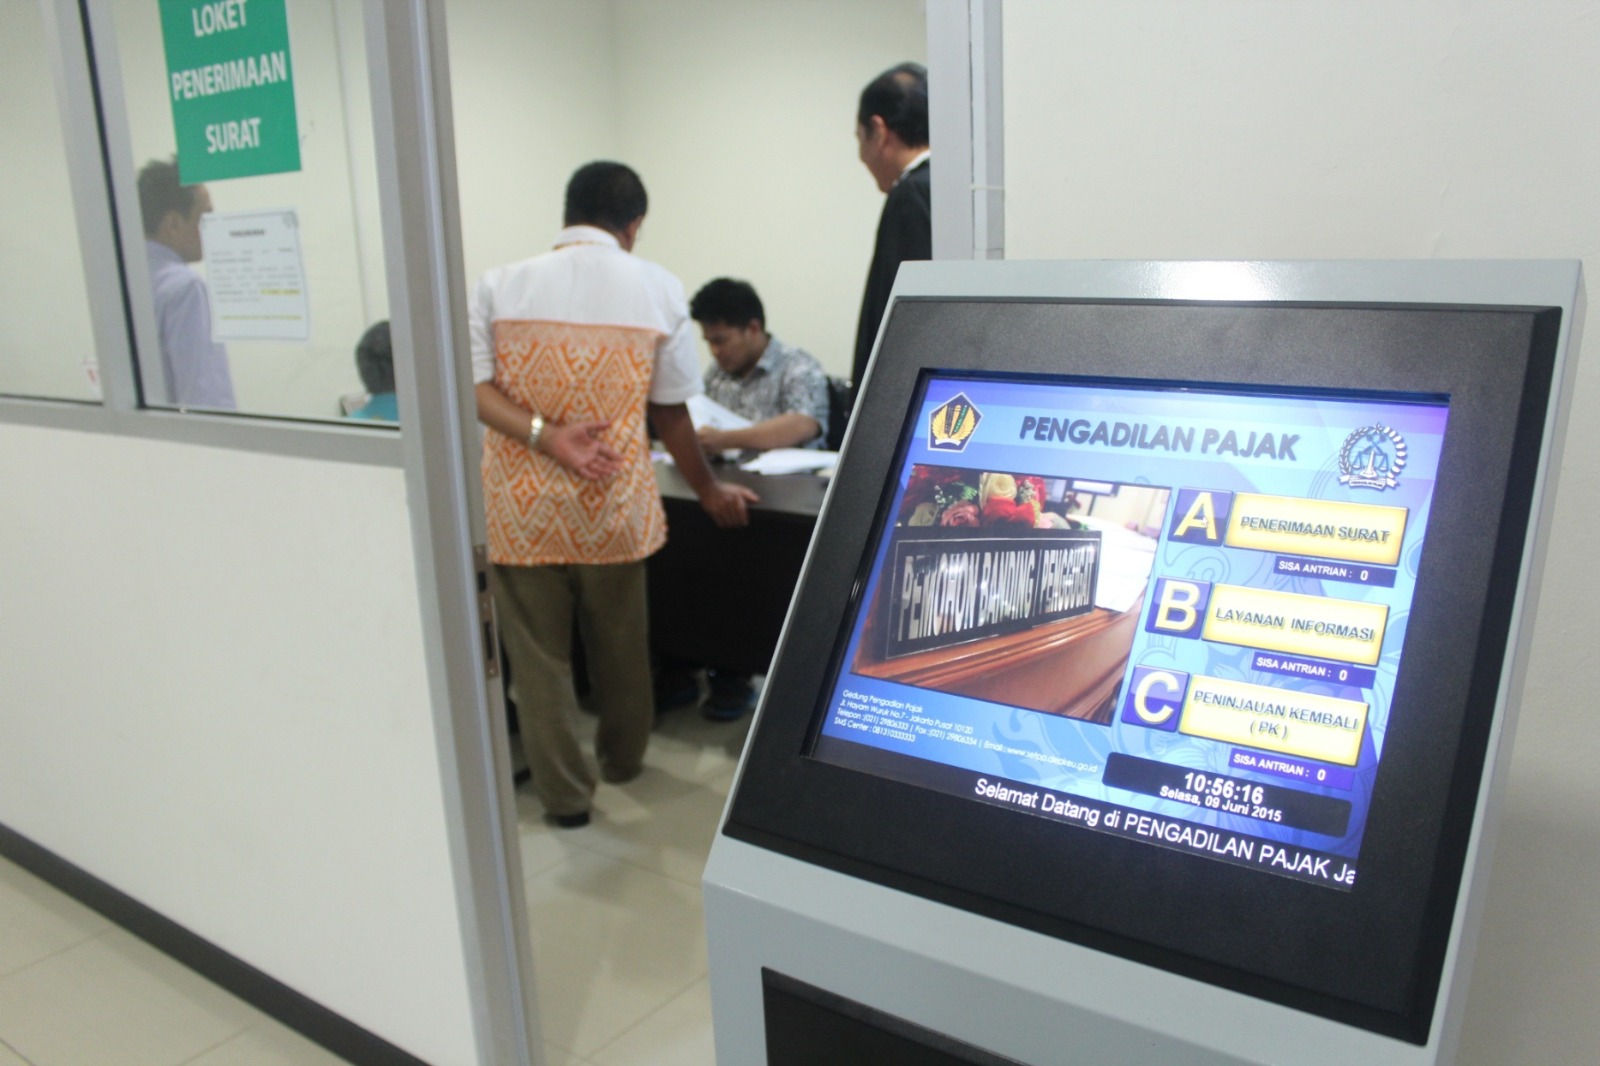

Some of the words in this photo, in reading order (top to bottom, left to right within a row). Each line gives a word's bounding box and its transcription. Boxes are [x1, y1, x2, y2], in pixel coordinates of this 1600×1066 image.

[192, 0, 247, 37] LOKET
[171, 50, 287, 101] PENERIMAAN
[205, 117, 261, 154] SURAT
[1019, 415, 1193, 453] PENGADILAN
[1200, 427, 1301, 462] PAJAK
[1174, 490, 1217, 541] A
[1240, 515, 1334, 538] PENERIMAAN
[1338, 526, 1391, 543] SURAT
[1278, 560, 1300, 572] SISA
[1302, 563, 1347, 578] ANTRIAN
[1359, 569, 1369, 581] 0
[897, 551, 980, 642] PEMOHON
[977, 548, 1036, 628] BANDING
[1155, 580, 1201, 632] B
[1216, 607, 1284, 627] LAYANAN
[1291, 618, 1375, 641] INFORMASI
[1256, 656, 1279, 670] SISA
[1280, 661, 1326, 677] ANTRIAN
[1338, 669, 1348, 681] 0
[837, 707, 861, 720] Telepon
[842, 689, 869, 703] Gedung
[869, 695, 904, 709] Pengadilan
[905, 703, 923, 714] Pajak
[1134, 671, 1180, 724] C
[1194, 690, 1286, 717] PENINJAUAN
[1289, 707, 1358, 730] KEMBALI
[834, 717, 847, 727] SMS
[847, 720, 869, 732] Center
[847, 701, 870, 712] Hayam
[870, 705, 889, 716] Wuruk
[909, 715, 935, 726] Jakarta
[934, 719, 953, 731] Pusat
[954, 723, 974, 735] 10120
[1233, 753, 1256, 766] SISA
[1257, 757, 1304, 776] ANTRIAN
[1316, 769, 1326, 781] 0
[1159, 785, 1201, 808] Selasa,
[1205, 795, 1220, 809] 09
[1221, 799, 1249, 815] Juni
[1250, 803, 1282, 823] 2015
[1184, 771, 1264, 805] 10:56:16
[975, 777, 1038, 809] Selamat
[1041, 790, 1100, 826] Datang
[1104, 807, 1120, 829] di
[1123, 812, 1254, 860] PENGADILAN
[1258, 844, 1331, 879] PAJAK
